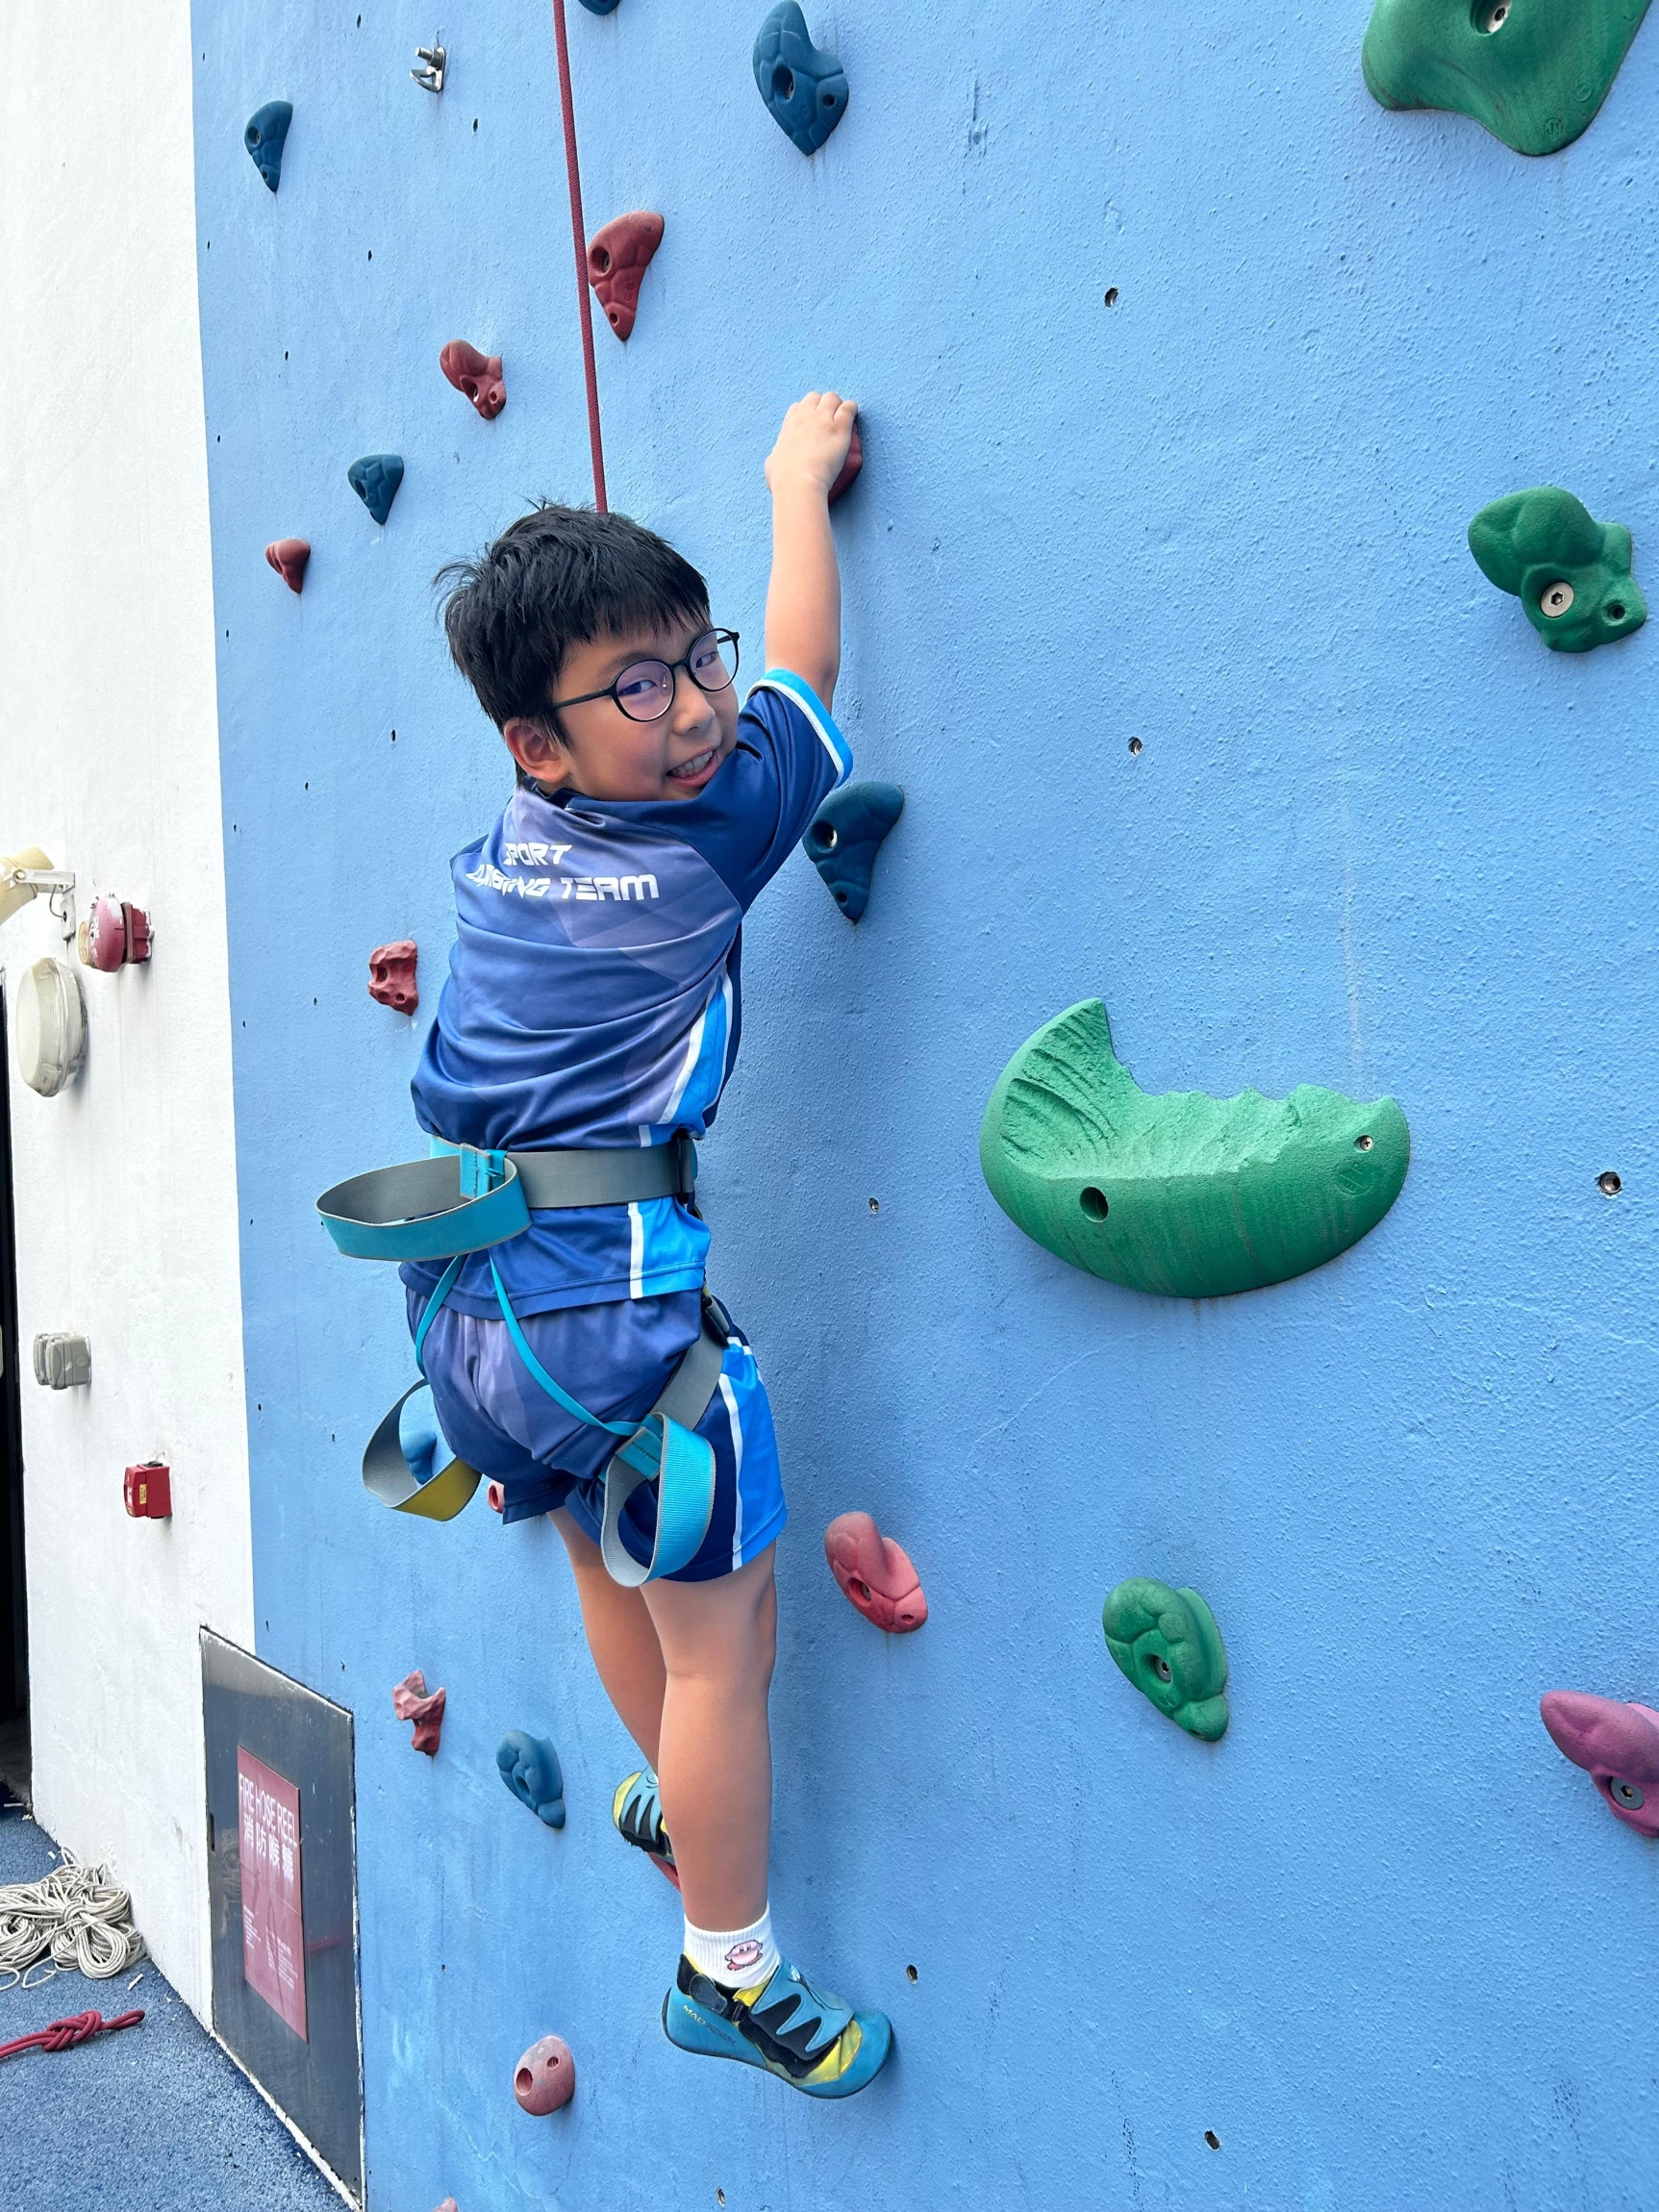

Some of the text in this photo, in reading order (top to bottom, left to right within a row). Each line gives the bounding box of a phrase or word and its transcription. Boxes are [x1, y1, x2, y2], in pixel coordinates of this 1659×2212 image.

[560, 873, 660, 901] TEAM
[239, 1772, 298, 1848] FIRE HOSE REEL
